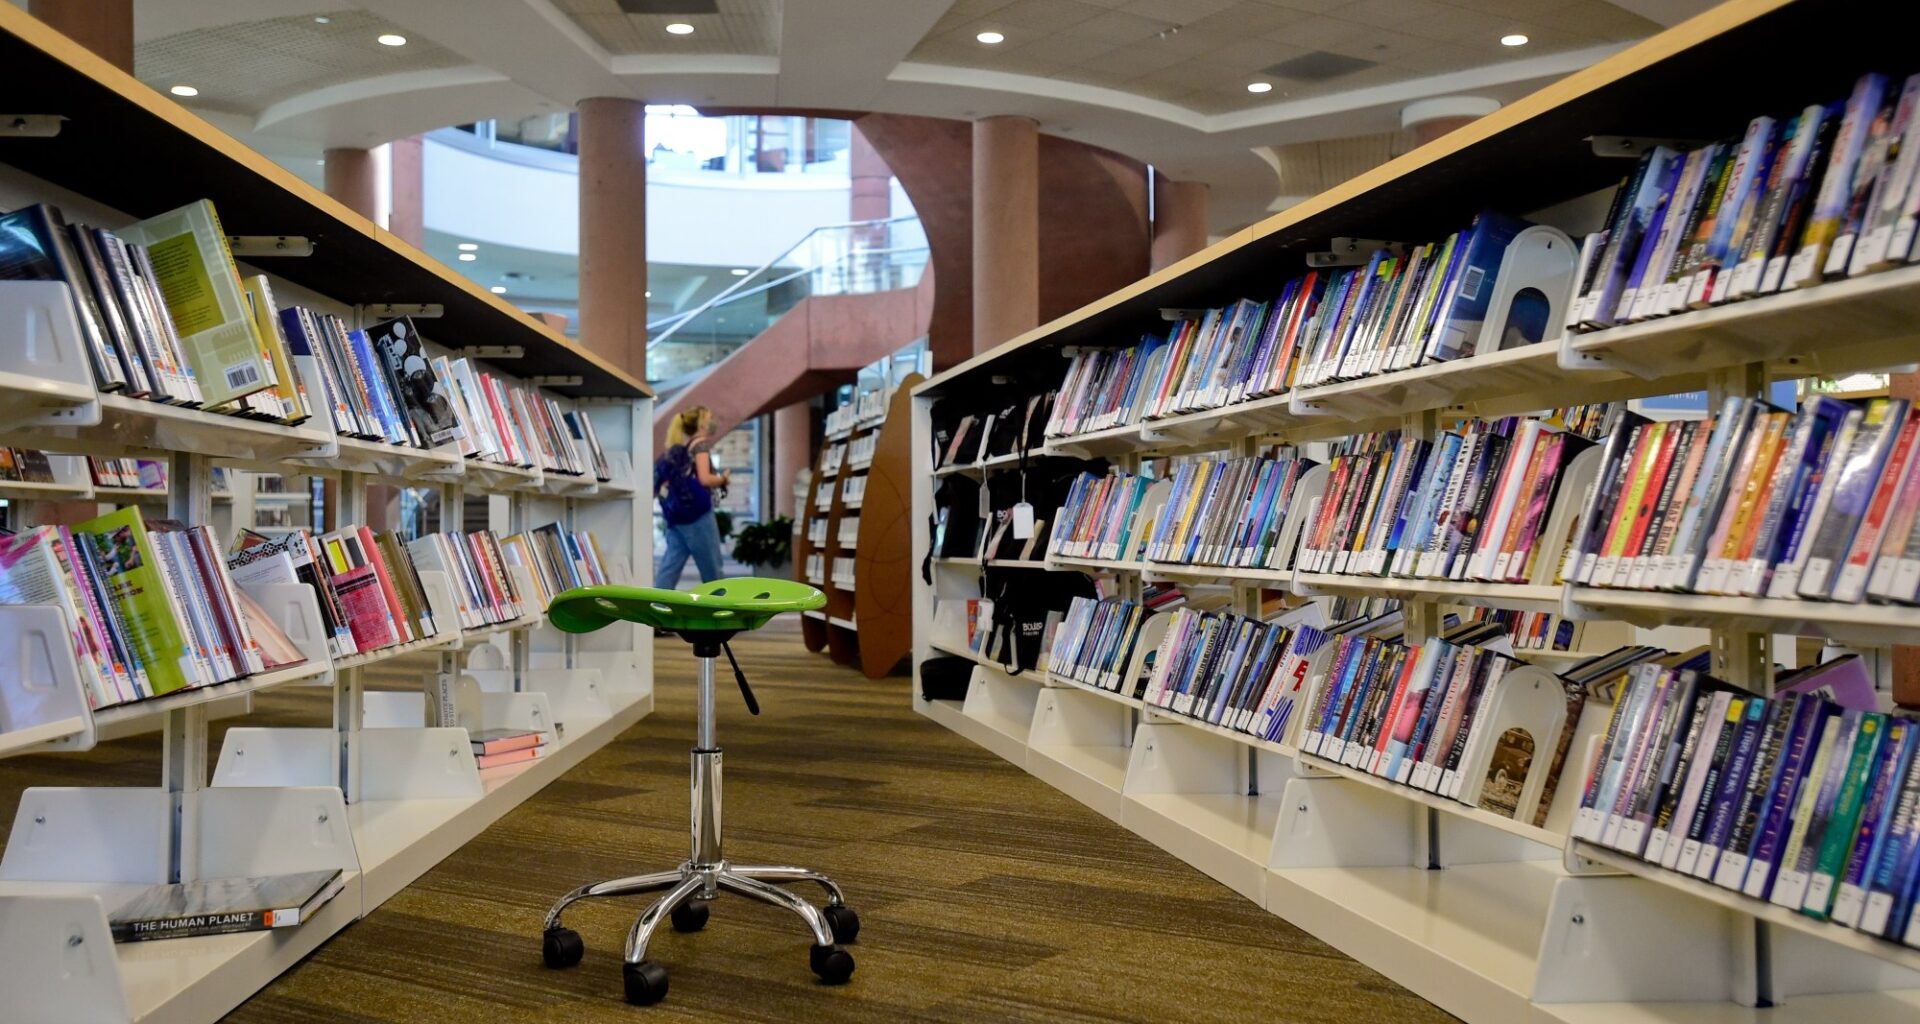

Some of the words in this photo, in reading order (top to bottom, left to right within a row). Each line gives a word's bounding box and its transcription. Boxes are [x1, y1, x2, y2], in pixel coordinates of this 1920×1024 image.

[1665, 499, 1681, 523] MAX
[1319, 678, 1335, 711] BINCHY
[1759, 723, 1774, 749] DALE
[1724, 754, 1746, 796] BROOKS
[1746, 750, 1766, 789] BROWN
[1753, 736, 1783, 797] BROWN
[1890, 789, 1916, 836] BROWN
[133, 921, 157, 931] THE
[159, 916, 205, 929] HUMAN
[208, 912, 253, 925] PLANET
